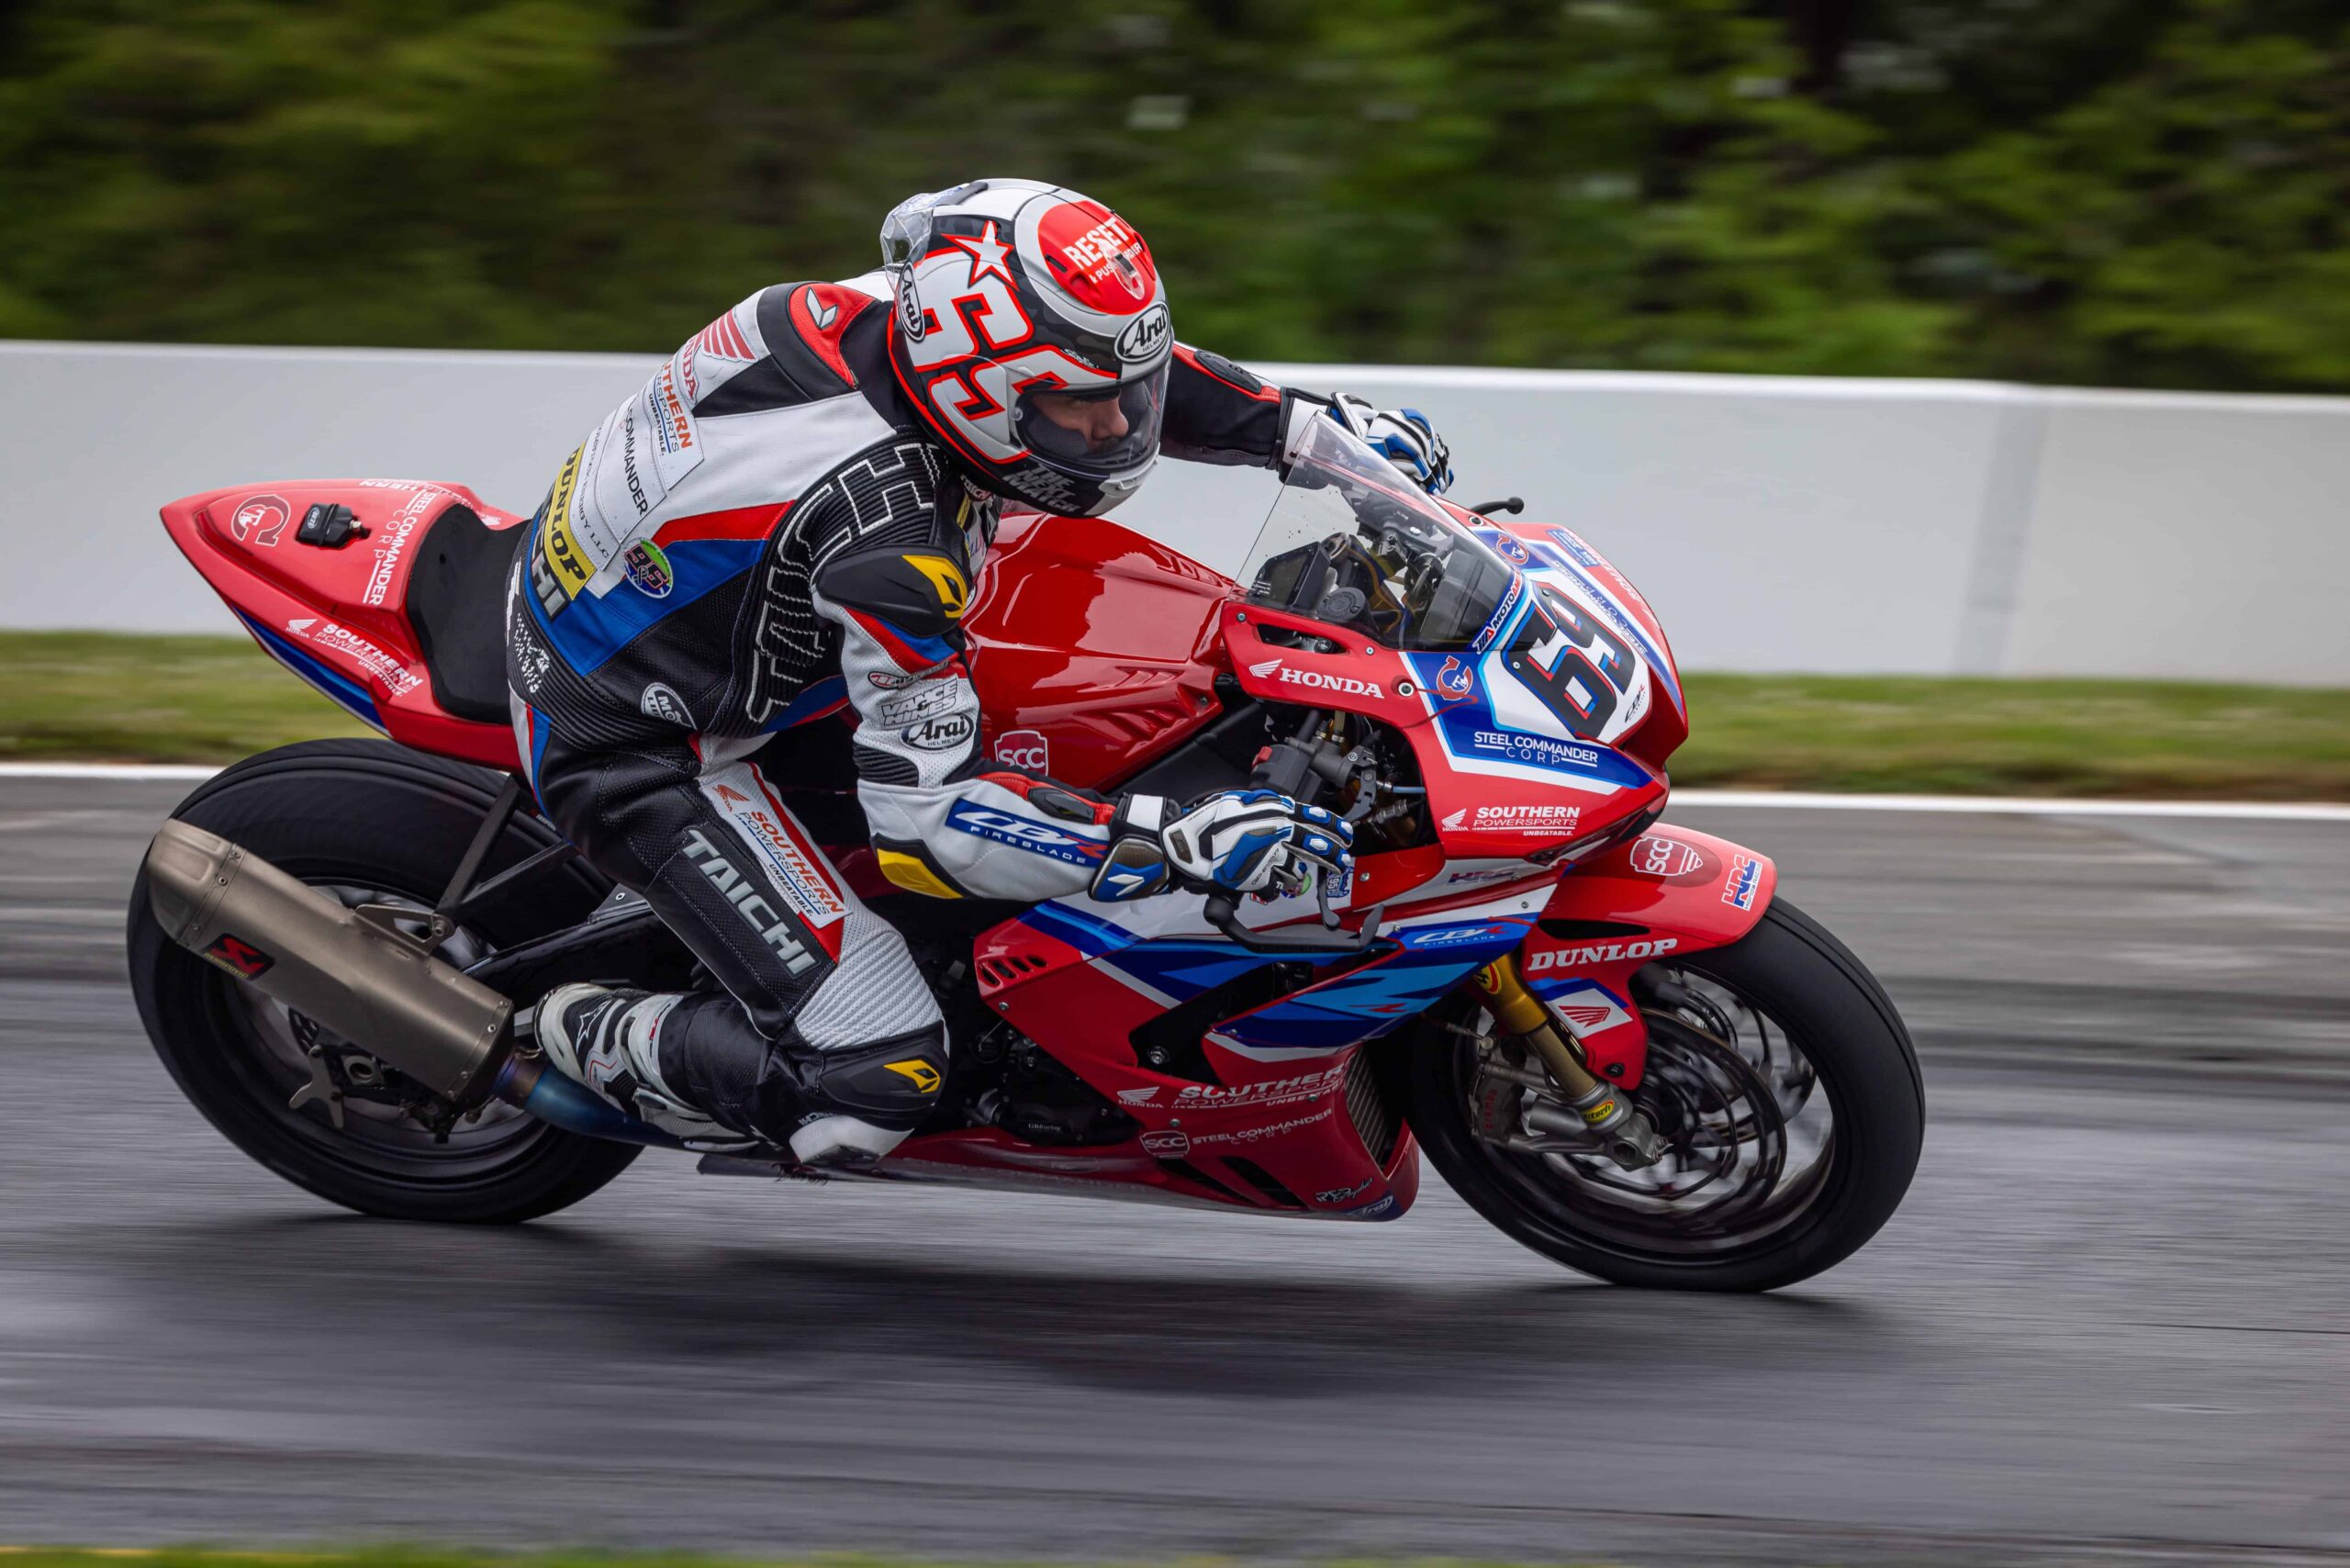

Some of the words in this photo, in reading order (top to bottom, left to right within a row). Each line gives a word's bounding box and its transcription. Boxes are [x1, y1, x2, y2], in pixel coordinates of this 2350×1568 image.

[1062, 216, 1130, 270] RESET
[901, 279, 922, 330] Arai
[1124, 306, 1167, 356] Arai
[655, 375, 680, 453] RSPORTS
[408, 491, 437, 515] STEEL
[551, 447, 586, 580] DUNLOP
[374, 510, 406, 559] CORP
[589, 532, 610, 559] LLC
[369, 517, 417, 606] COMMANDER
[316, 632, 414, 692] POWERSPORTS
[323, 623, 423, 687] SOUTHERN
[881, 678, 957, 717] VANCE
[1279, 668, 1384, 700] HONDA
[884, 696, 957, 727] HINES
[907, 715, 968, 743] Arai
[927, 738, 957, 746] HELMET
[999, 745, 1046, 769] SCC
[1473, 731, 1513, 746] STEEL
[1514, 735, 1598, 763] COMMANDER
[1505, 746, 1561, 765] CORP
[1473, 818, 1577, 827] POWERSPORTS
[1476, 806, 1580, 819] SOUTHERN
[954, 811, 1109, 857] CBR
[970, 825, 1086, 865] FIREBLADE
[740, 812, 830, 915] POWERSPORTS
[751, 811, 845, 913] SOUTHERN
[1645, 839, 1673, 873] SCC
[682, 829, 816, 976] TAICHI
[769, 863, 813, 917] UNBEATABLE.
[1425, 935, 1495, 946] FIREBLADE
[1527, 937, 1678, 972] DUNLOP
[1179, 1063, 1345, 1099] SOUTHER
[1144, 1137, 1187, 1148] SCC
[1192, 1132, 1232, 1145] STEEL
[1237, 1108, 1332, 1139] COMMANDER
